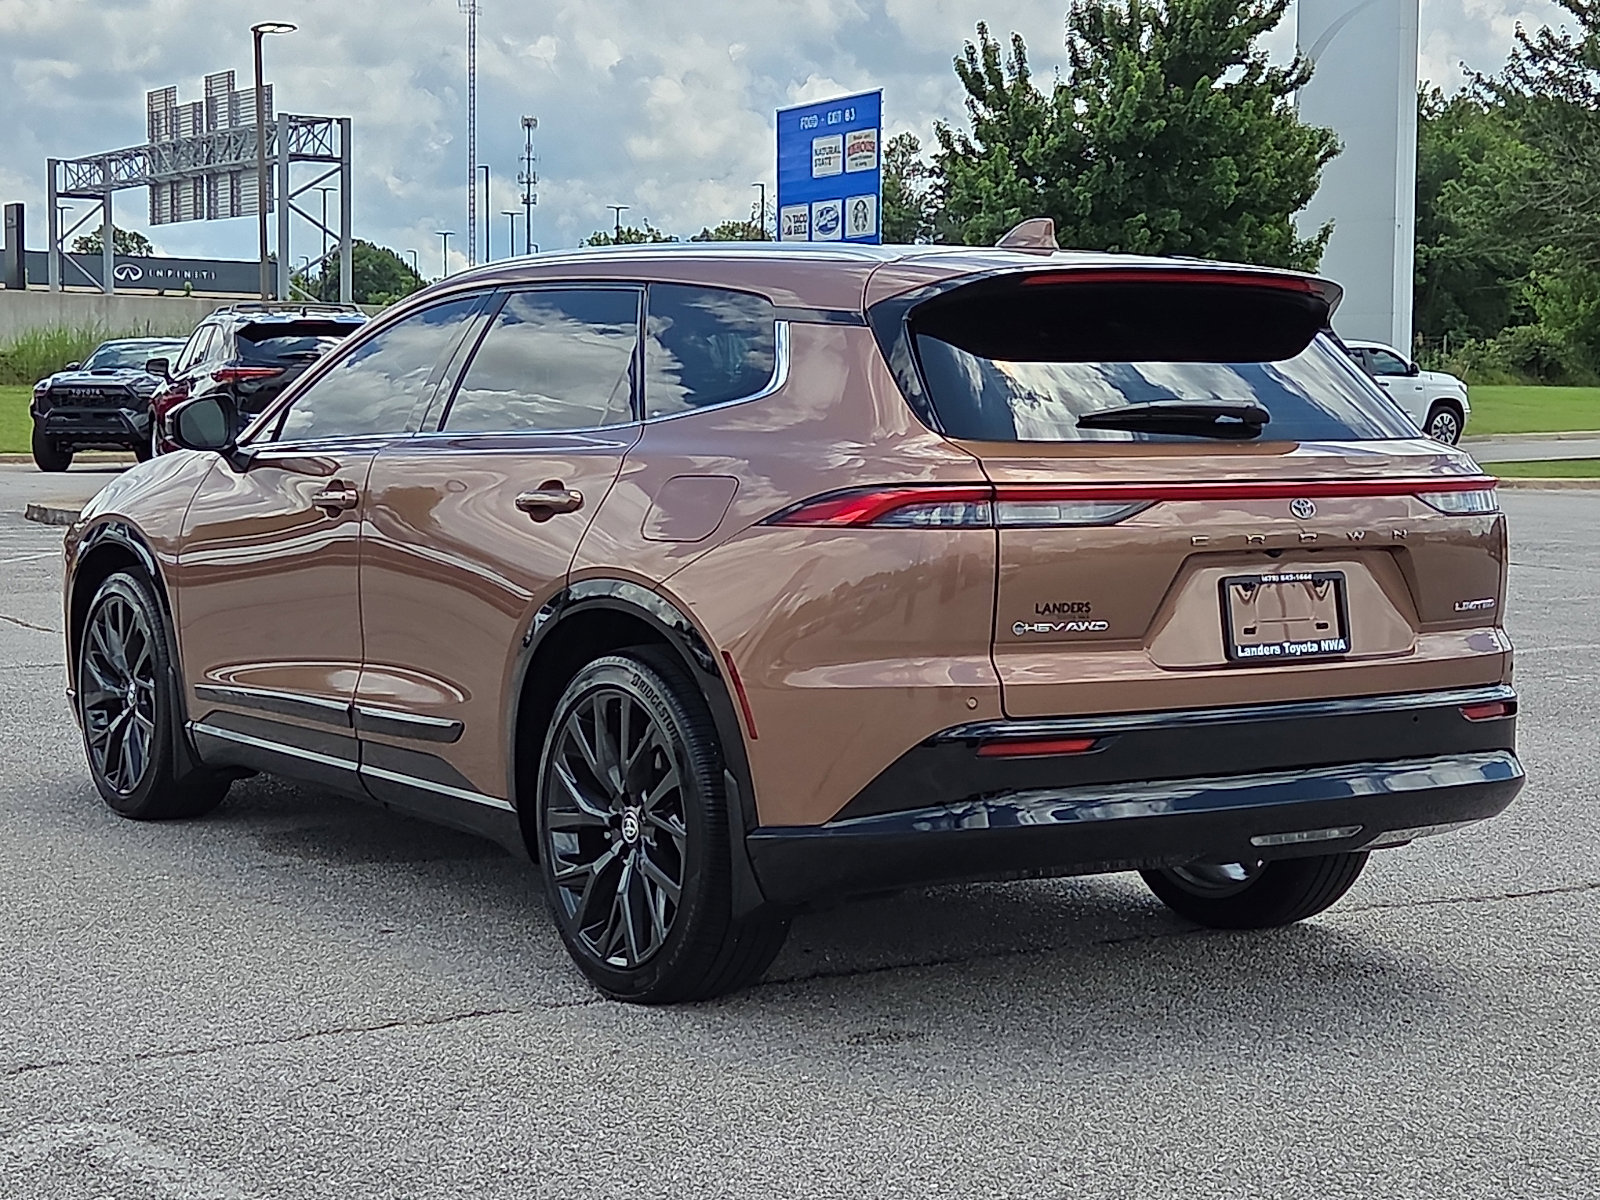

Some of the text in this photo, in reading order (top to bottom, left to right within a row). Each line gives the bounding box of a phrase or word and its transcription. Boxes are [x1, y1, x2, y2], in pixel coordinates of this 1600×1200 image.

[800, 115, 818, 130] FOOD
[828, 110, 842, 125] EXIT
[814, 145, 841, 156] NATURAL
[814, 156, 832, 167] STATE
[793, 213, 808, 224] TACO
[793, 224, 807, 235] BELL
[148, 269, 216, 280] INFINITI
[71, 388, 101, 397] TOYOTA
[1191, 529, 1408, 546] CROWN
[1035, 602, 1091, 615] LANDERS
[1237, 639, 1346, 657] Landers Toyota NWA
